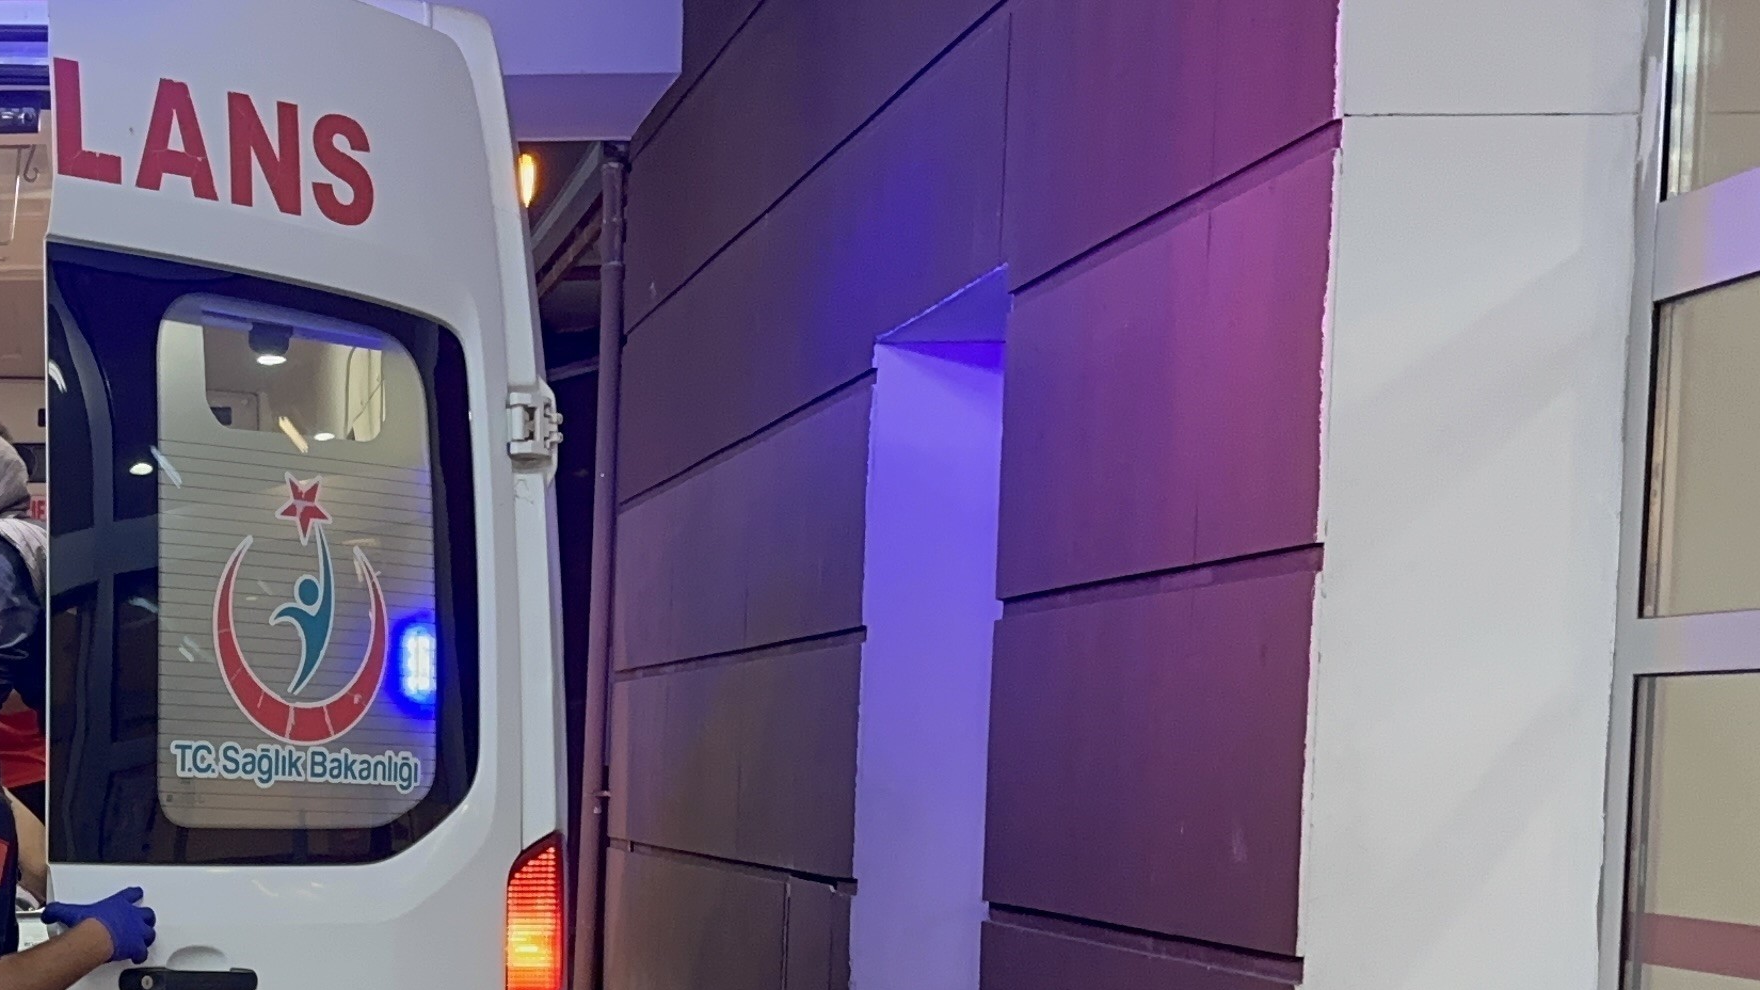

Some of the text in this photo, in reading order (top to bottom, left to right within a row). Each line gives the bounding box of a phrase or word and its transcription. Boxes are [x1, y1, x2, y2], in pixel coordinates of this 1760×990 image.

[53, 57, 374, 226] LANS
[222, 745, 303, 784] Sağlık
[309, 747, 419, 790] Bakanlığı
